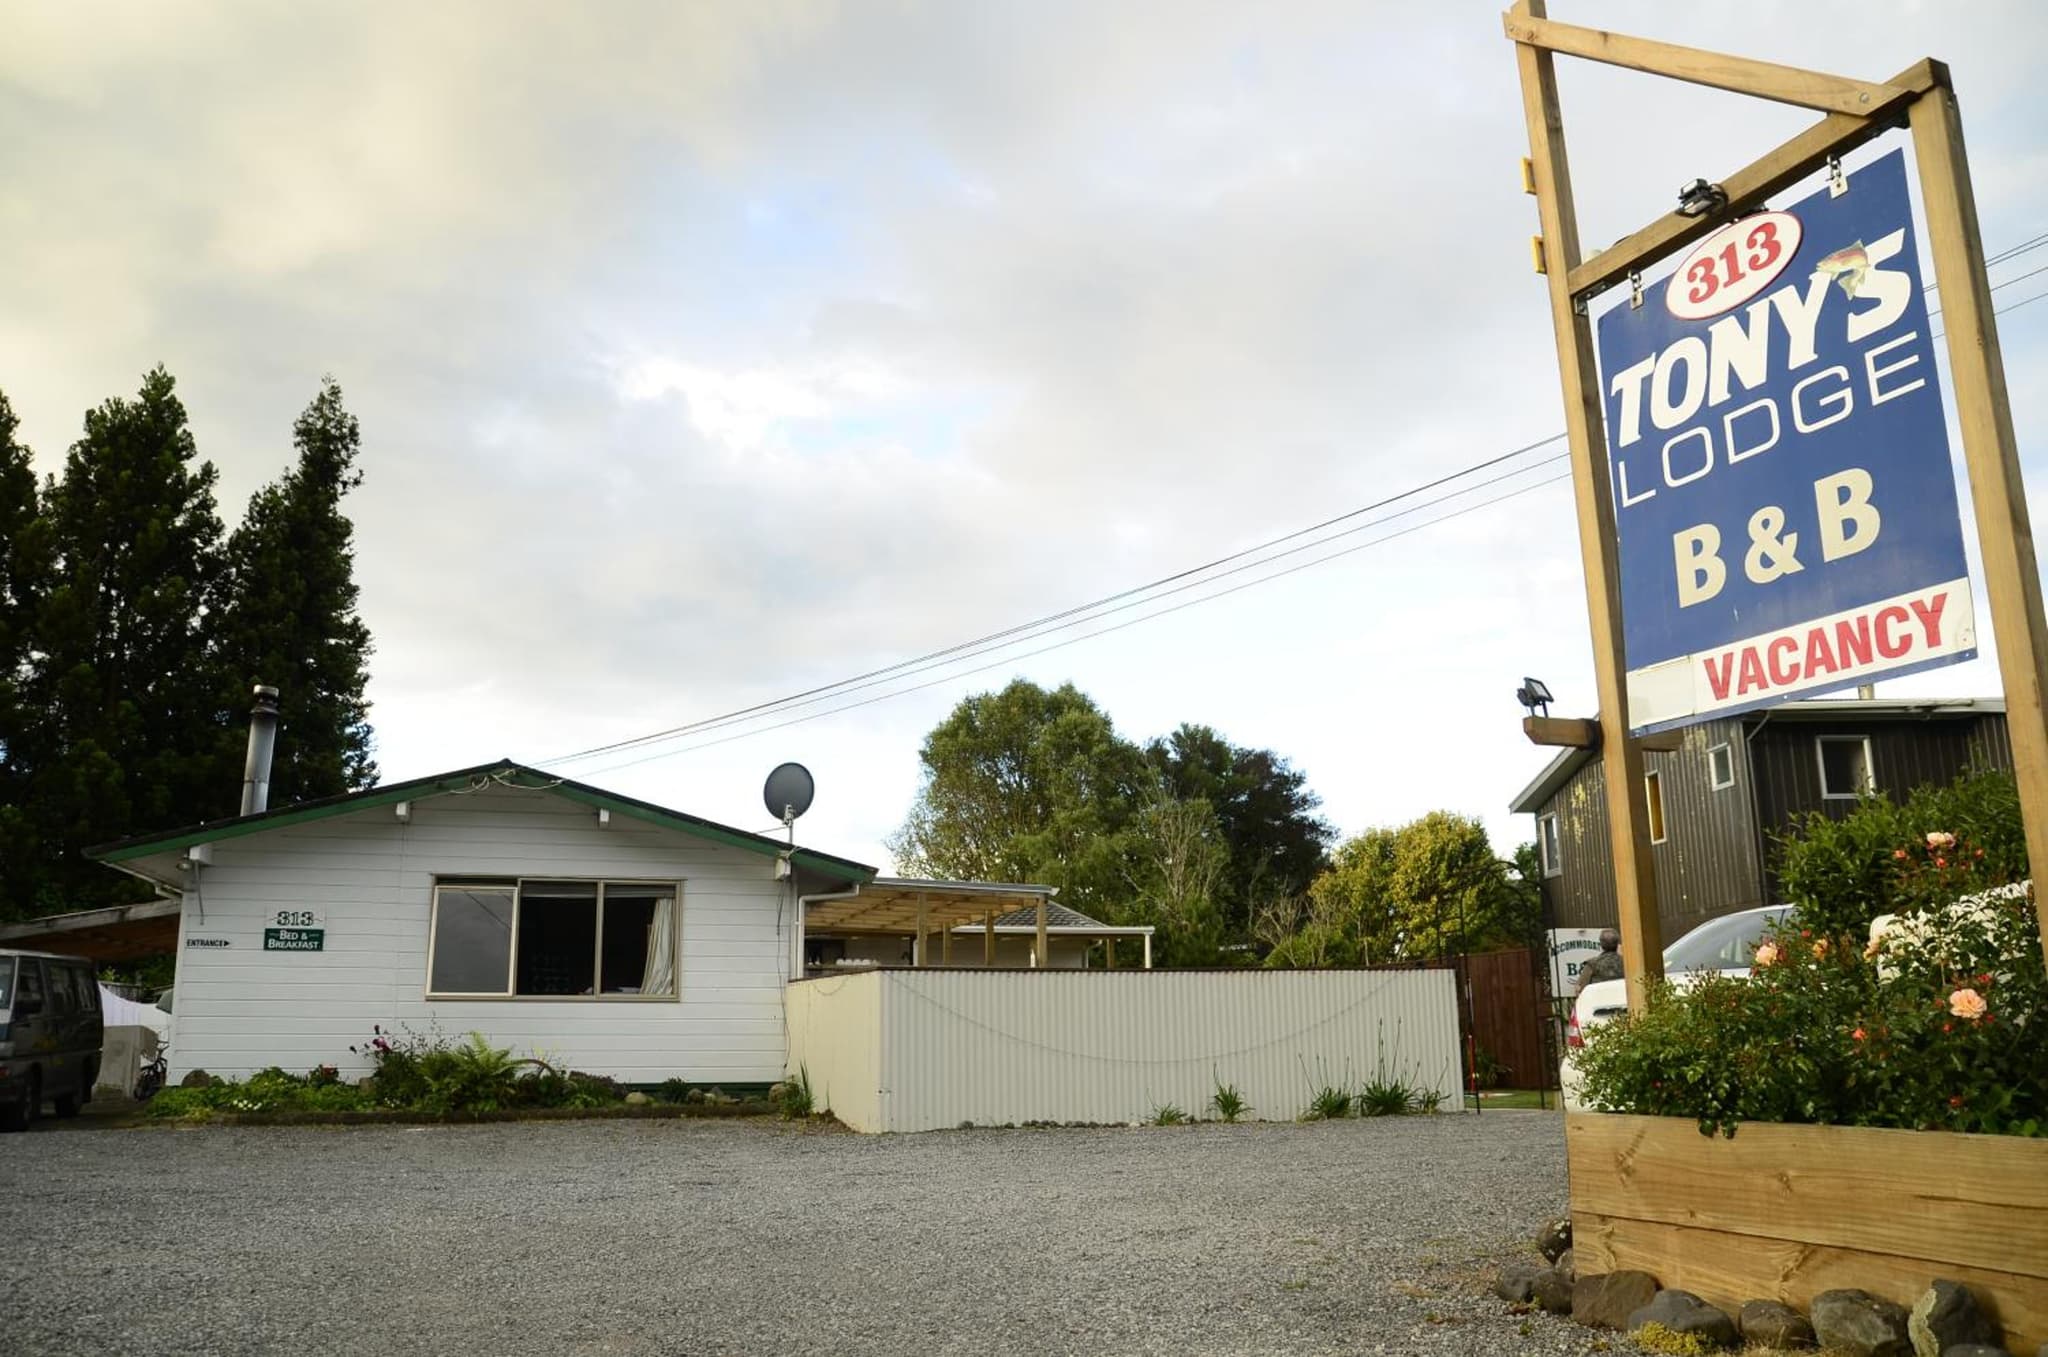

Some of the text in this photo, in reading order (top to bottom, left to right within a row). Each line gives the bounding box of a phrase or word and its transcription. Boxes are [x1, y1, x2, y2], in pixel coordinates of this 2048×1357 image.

[1687, 222, 1781, 304] 313
[1619, 332, 1926, 506] LODGE
[1703, 592, 1948, 701] VACANCY
[277, 911, 314, 926] 313
[279, 930, 299, 940] BED
[187, 939, 223, 947] ENTRANCE
[268, 938, 319, 949] BREAKFAST
